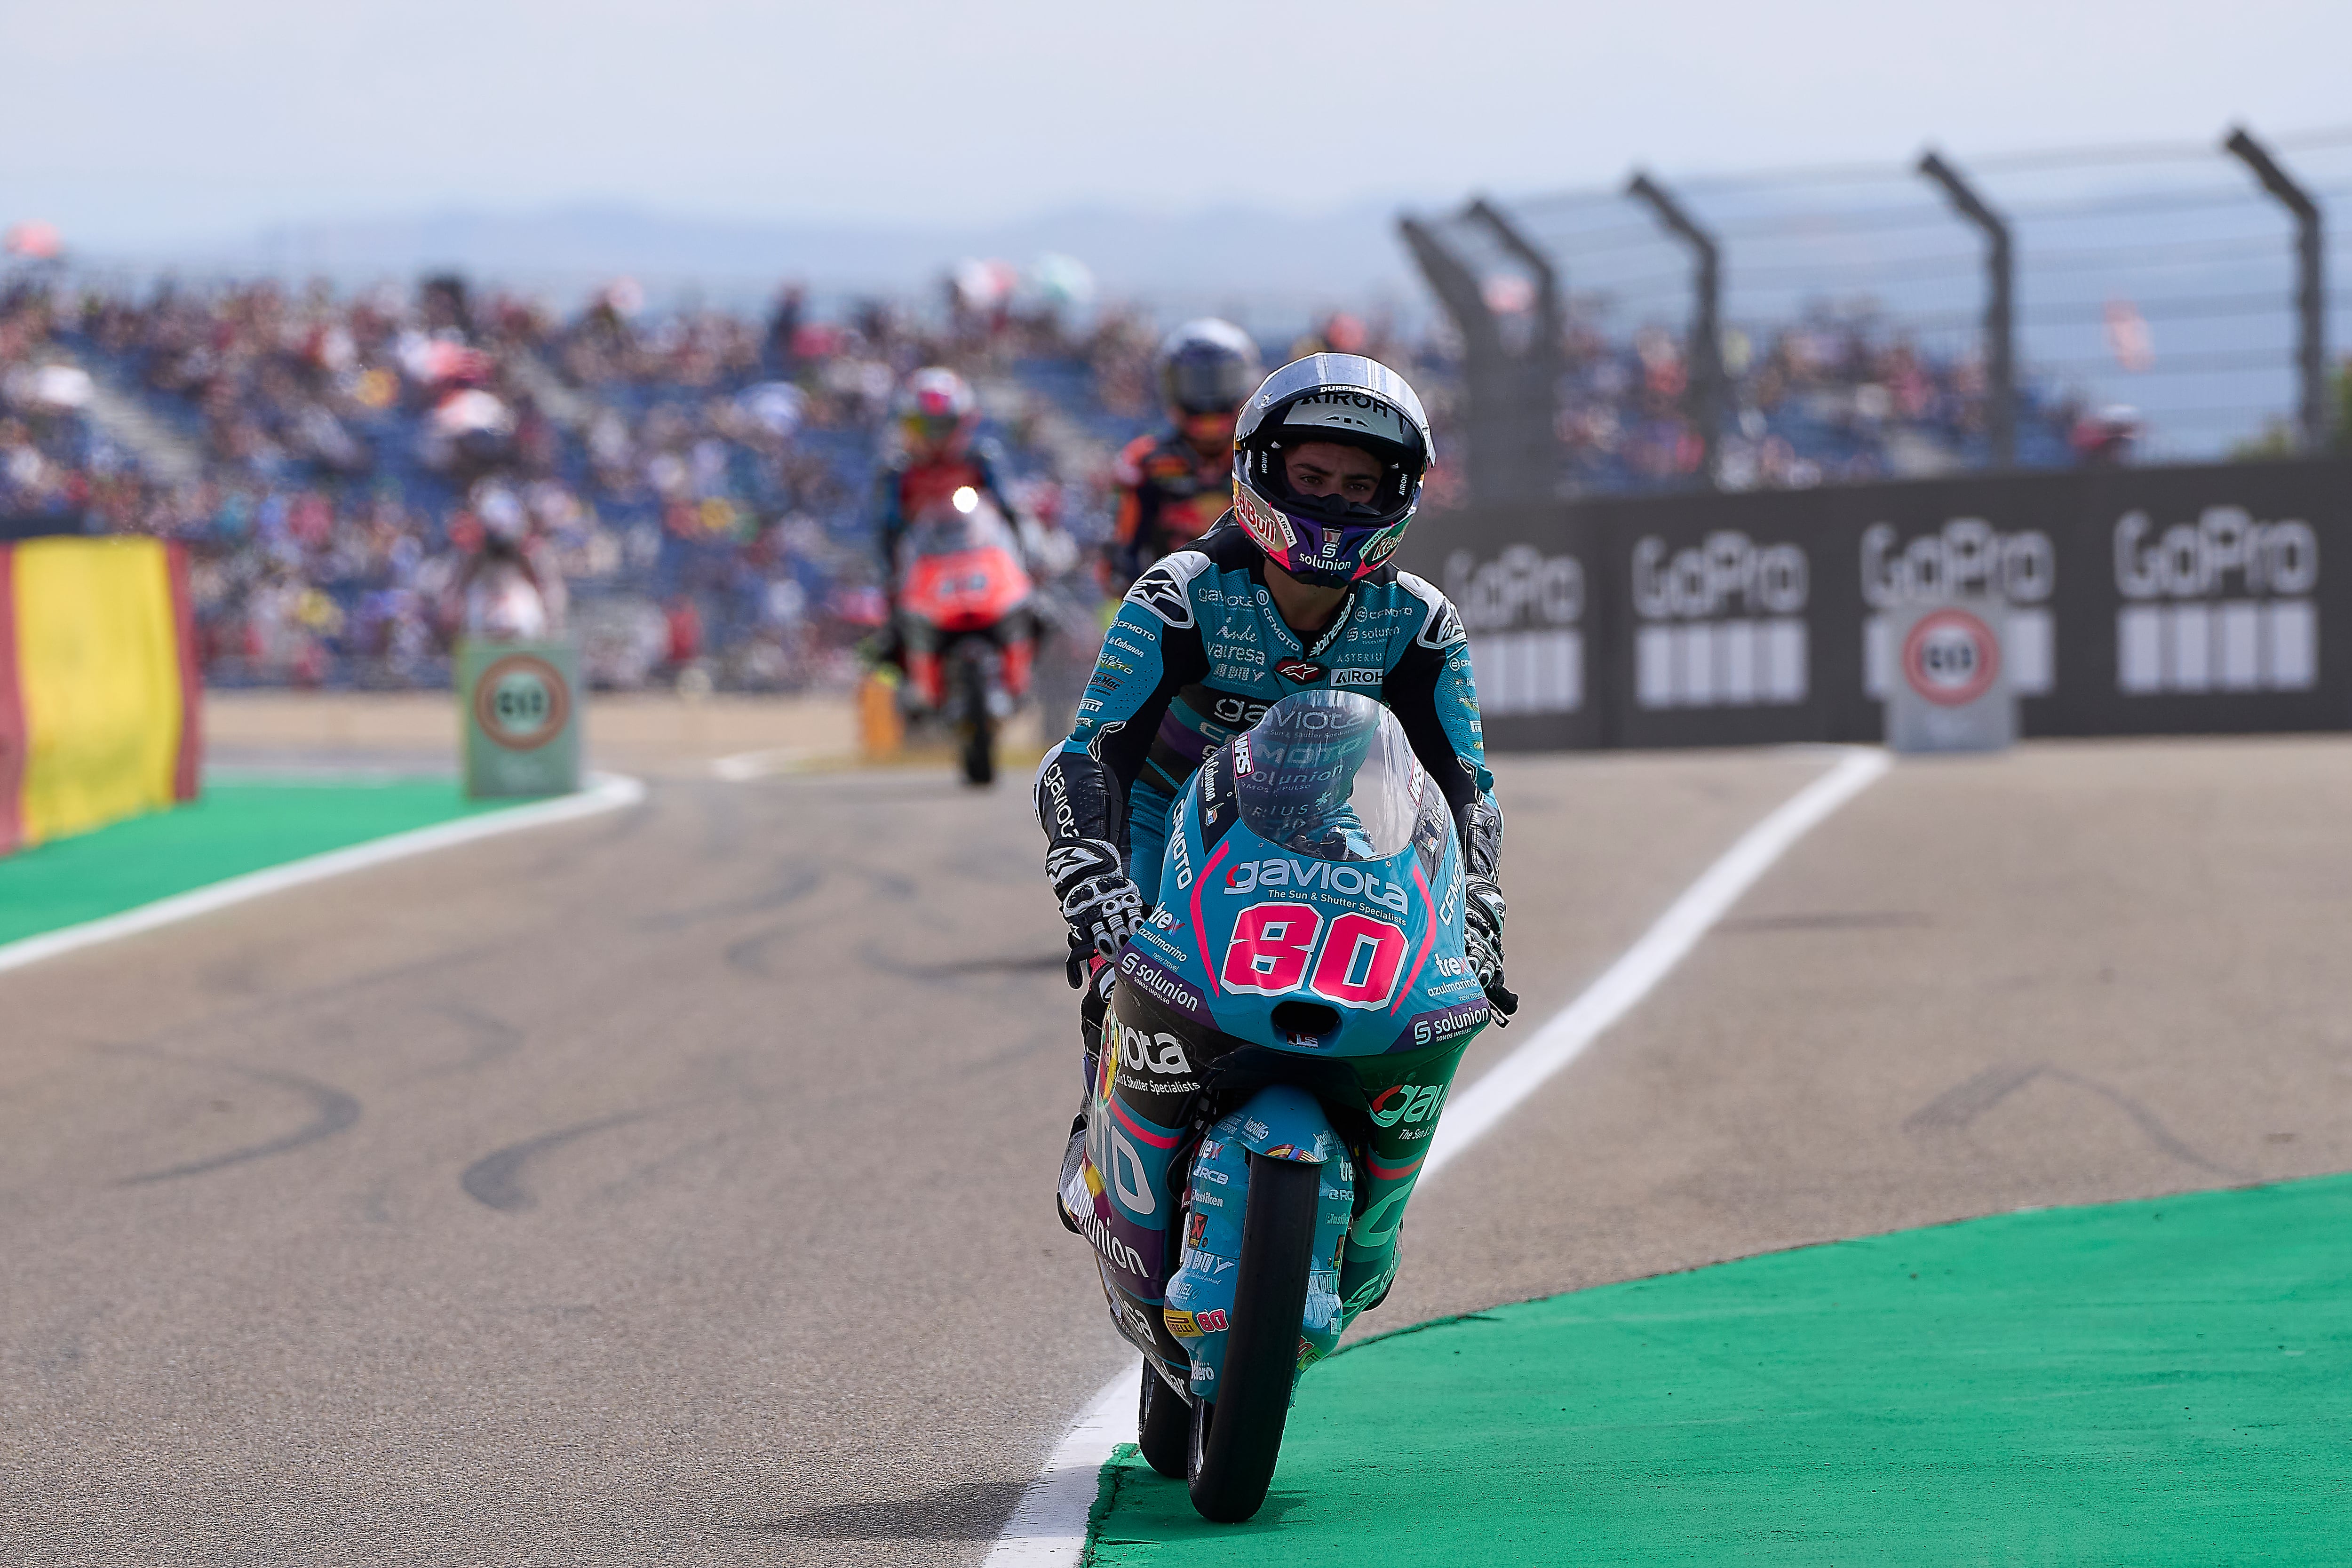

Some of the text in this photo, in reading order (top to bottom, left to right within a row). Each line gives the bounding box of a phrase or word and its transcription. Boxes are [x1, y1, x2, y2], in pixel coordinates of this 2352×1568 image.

[1300, 394, 1387, 418] AIROH
[1398, 474, 1408, 496] AIROH
[1246, 497, 1277, 545] Bull
[1277, 515, 1294, 542] AIROH
[1362, 530, 1385, 555] AIROH
[2113, 505, 2318, 598] GoPro
[1299, 551, 1351, 570] solunion
[1860, 517, 2055, 608] GoPro
[1445, 544, 1586, 628] GoPro
[1631, 529, 1811, 620] GoPro
[1369, 607, 1412, 619] CFMOTO
[1117, 621, 1156, 641] CFMOTO
[1263, 607, 1300, 652] CFMOTO
[1114, 637, 1144, 658] Cabanon
[1337, 653, 1382, 662] ASTERIU
[1335, 671, 1383, 684] AIROH
[1234, 735, 1252, 774] WRS
[1252, 764, 1343, 787] olunion
[1172, 798, 1192, 890] CFMOTO
[1224, 859, 1408, 915] gaviota
[1439, 859, 1462, 927] CFMO
[1268, 890, 1407, 926] The Sun & Shutter Specialists
[1137, 927, 1188, 963] azulmarino
[1220, 901, 1409, 1011] 80
[1152, 952, 1180, 972] new travel
[1134, 976, 1170, 1005] SOMOS IMPULSO
[1136, 964, 1199, 1012] solunion
[1427, 978, 1478, 997] azulmarino
[1434, 1006, 1488, 1035] solunion
[1119, 1021, 1192, 1074] iota
[1436, 1033, 1454, 1042] SOMOS
[1127, 1075, 1149, 1092] Shutter
[1149, 1080, 1200, 1096] Specialists
[1398, 1129, 1413, 1140] The
[1412, 1128, 1424, 1140] Sun
[1340, 1156, 1353, 1181] tre
[1196, 1308, 1229, 1333] 80
